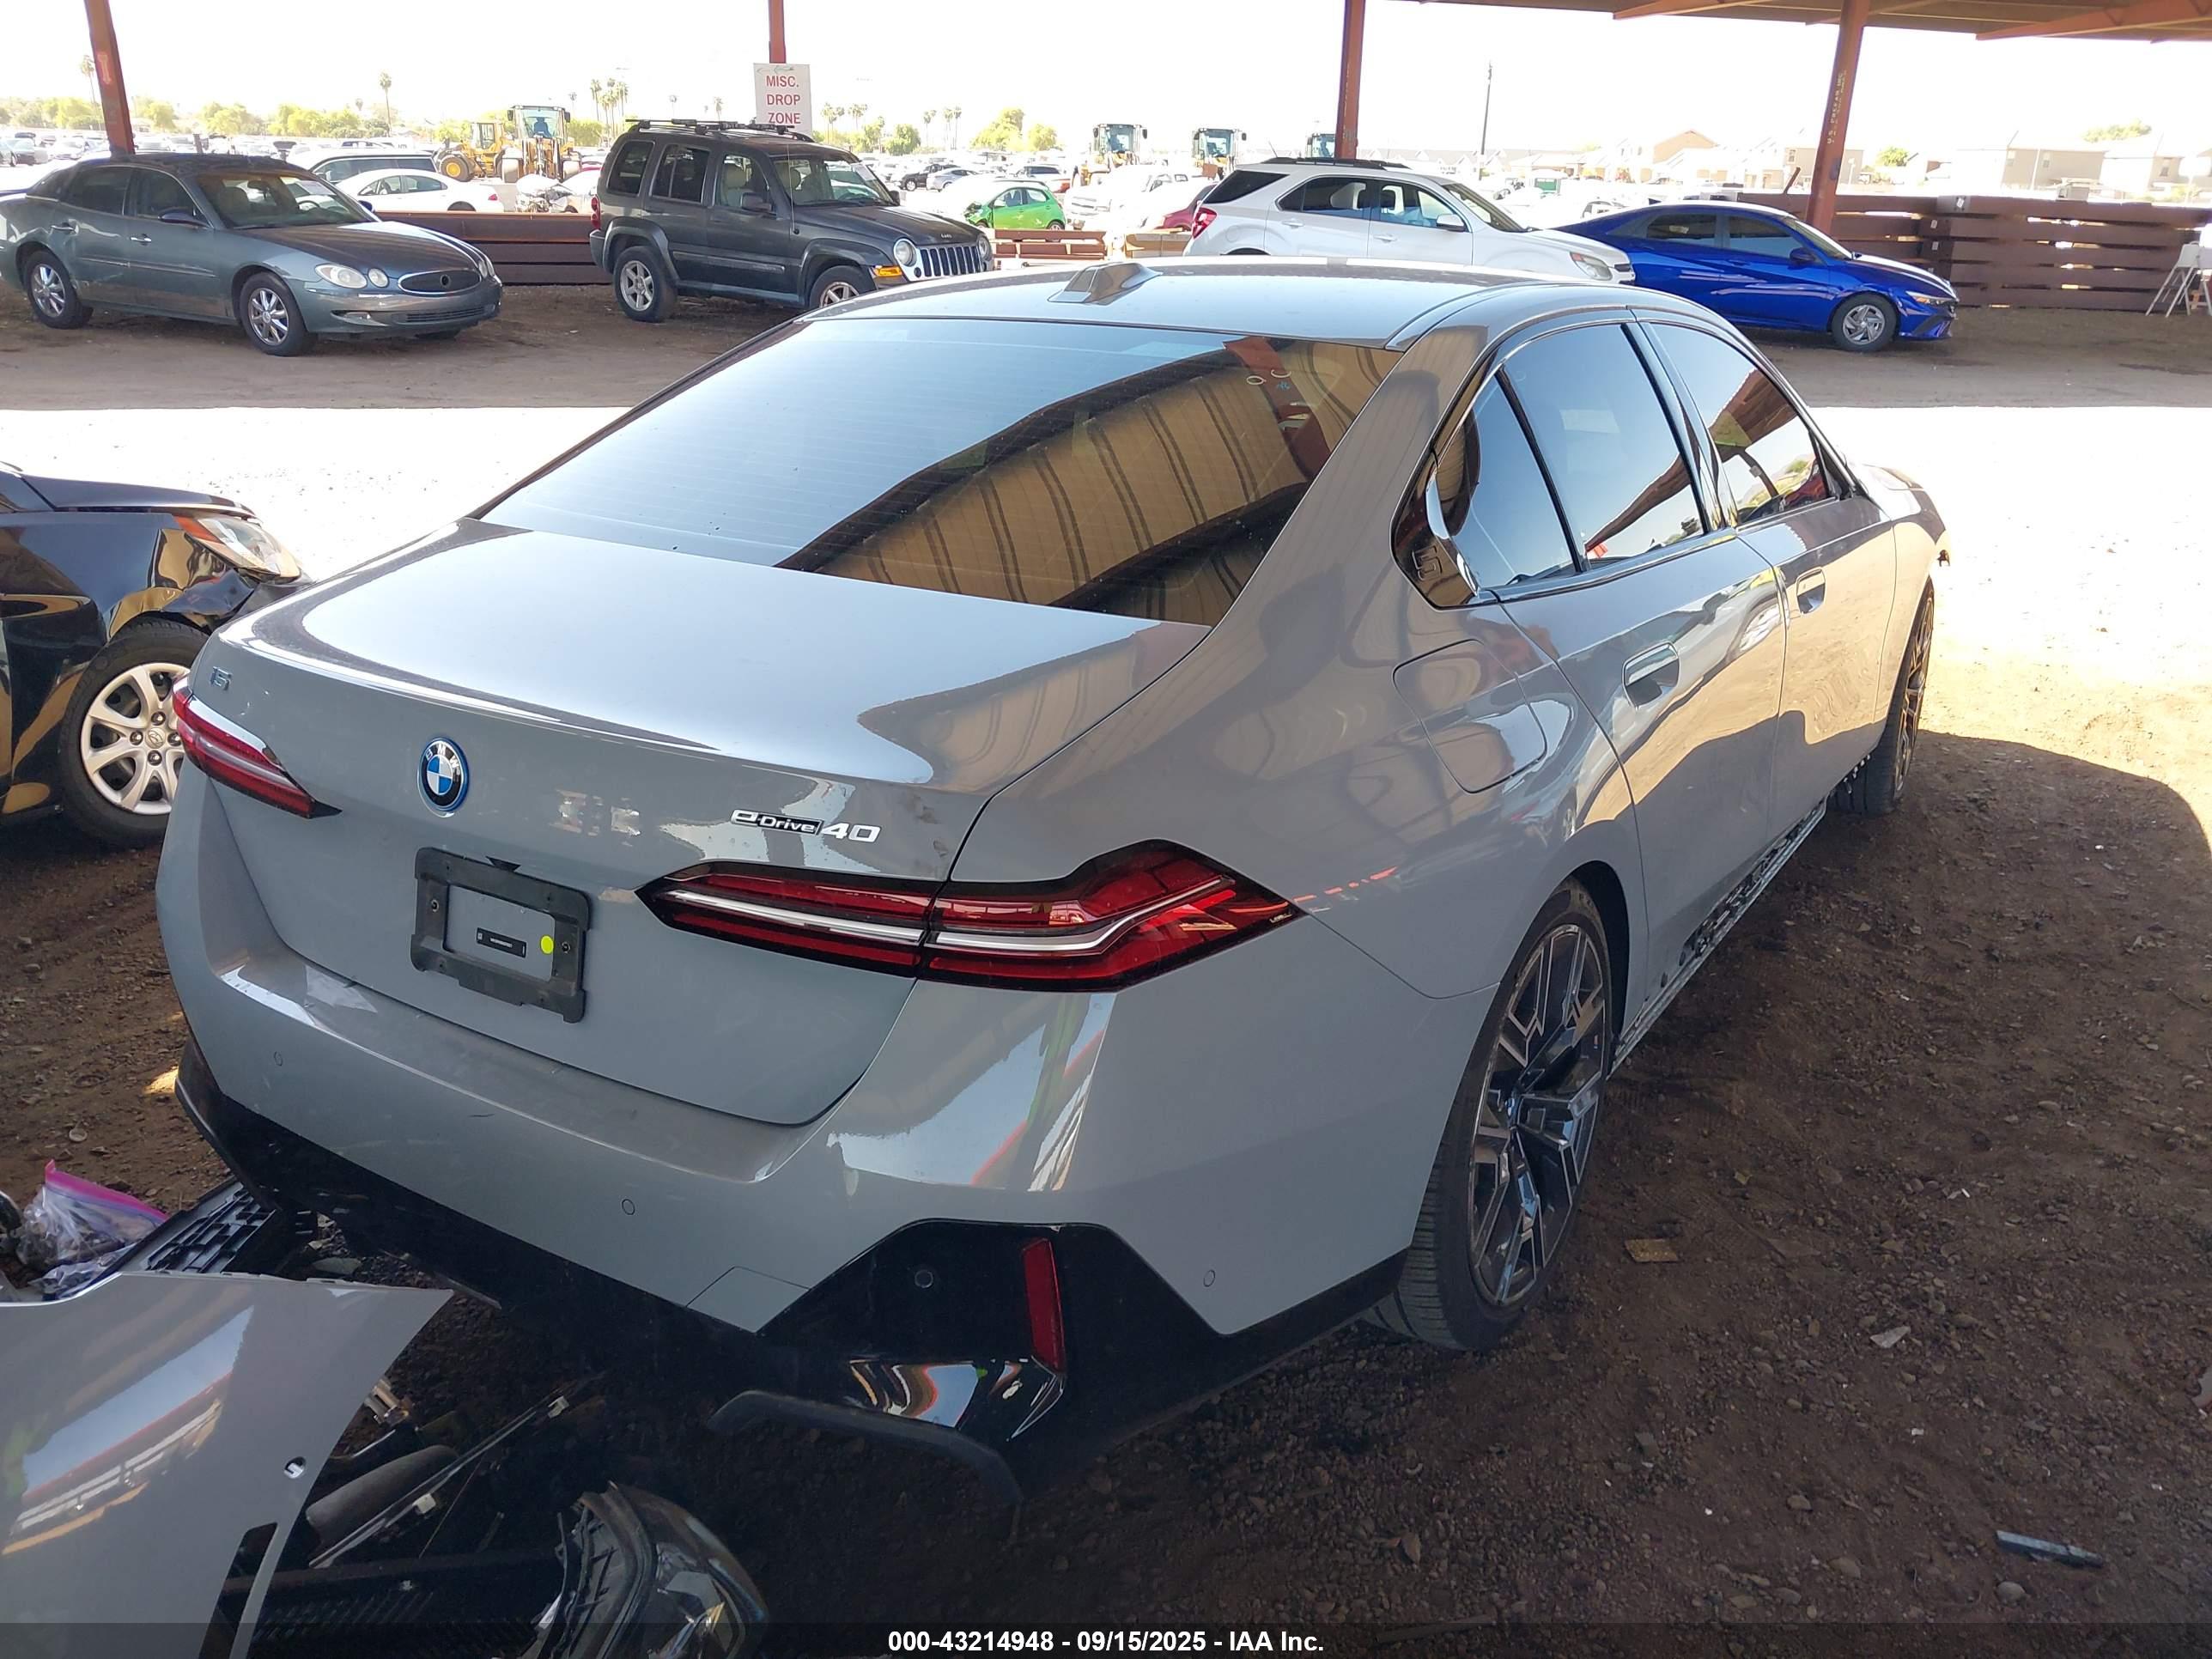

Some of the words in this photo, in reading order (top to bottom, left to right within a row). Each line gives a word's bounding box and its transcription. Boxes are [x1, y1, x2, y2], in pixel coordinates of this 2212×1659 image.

[766, 75, 799, 88] MISC.
[766, 94, 801, 106] DROP
[768, 112, 801, 125] ZONE
[425, 743, 460, 769] BMW
